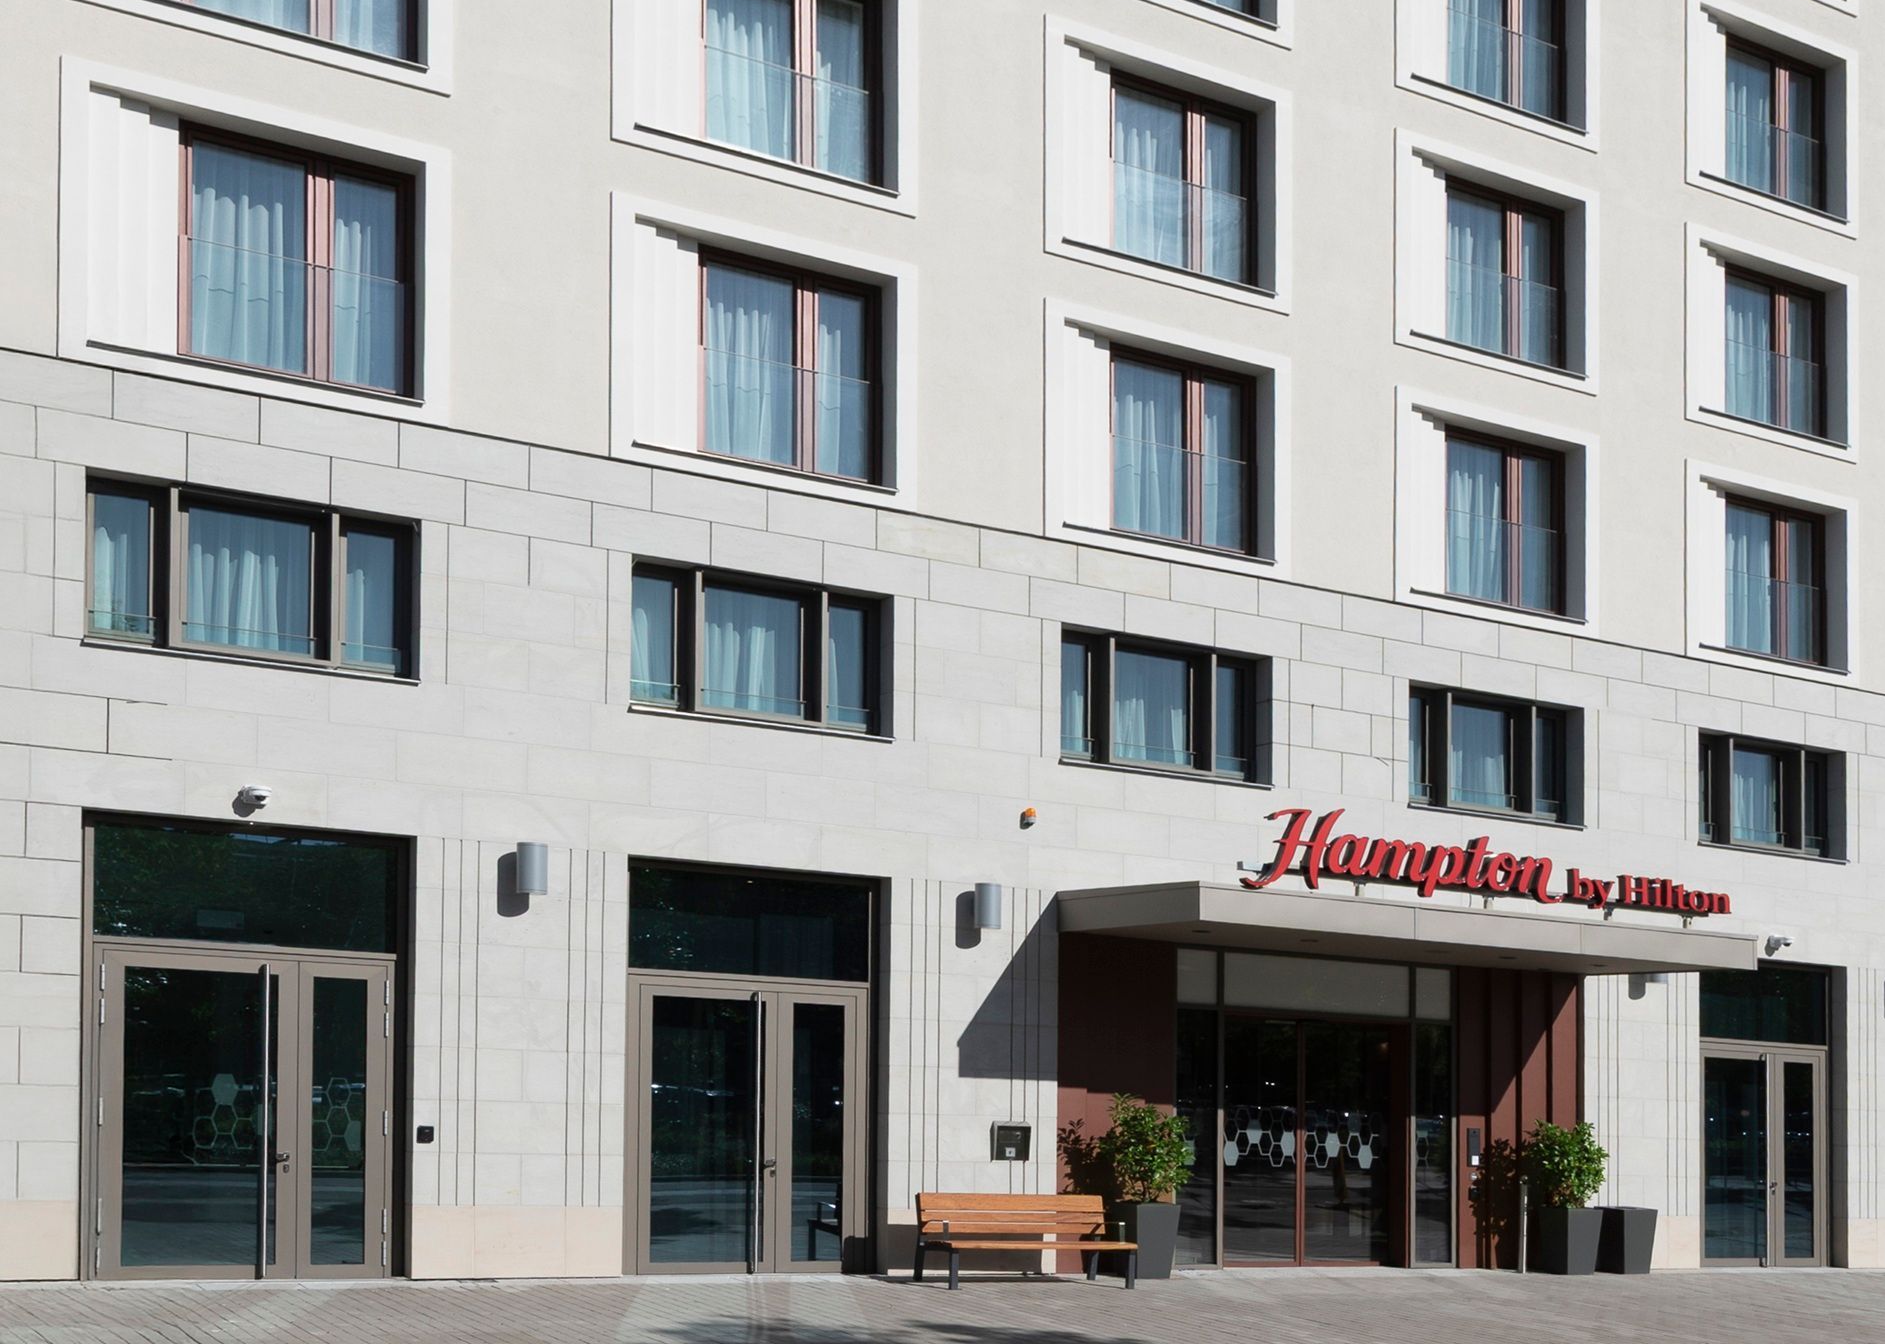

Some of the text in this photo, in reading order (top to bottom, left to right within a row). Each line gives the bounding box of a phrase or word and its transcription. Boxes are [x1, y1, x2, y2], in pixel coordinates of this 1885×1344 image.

[1240, 808, 1732, 914] Hampton by Hilton
